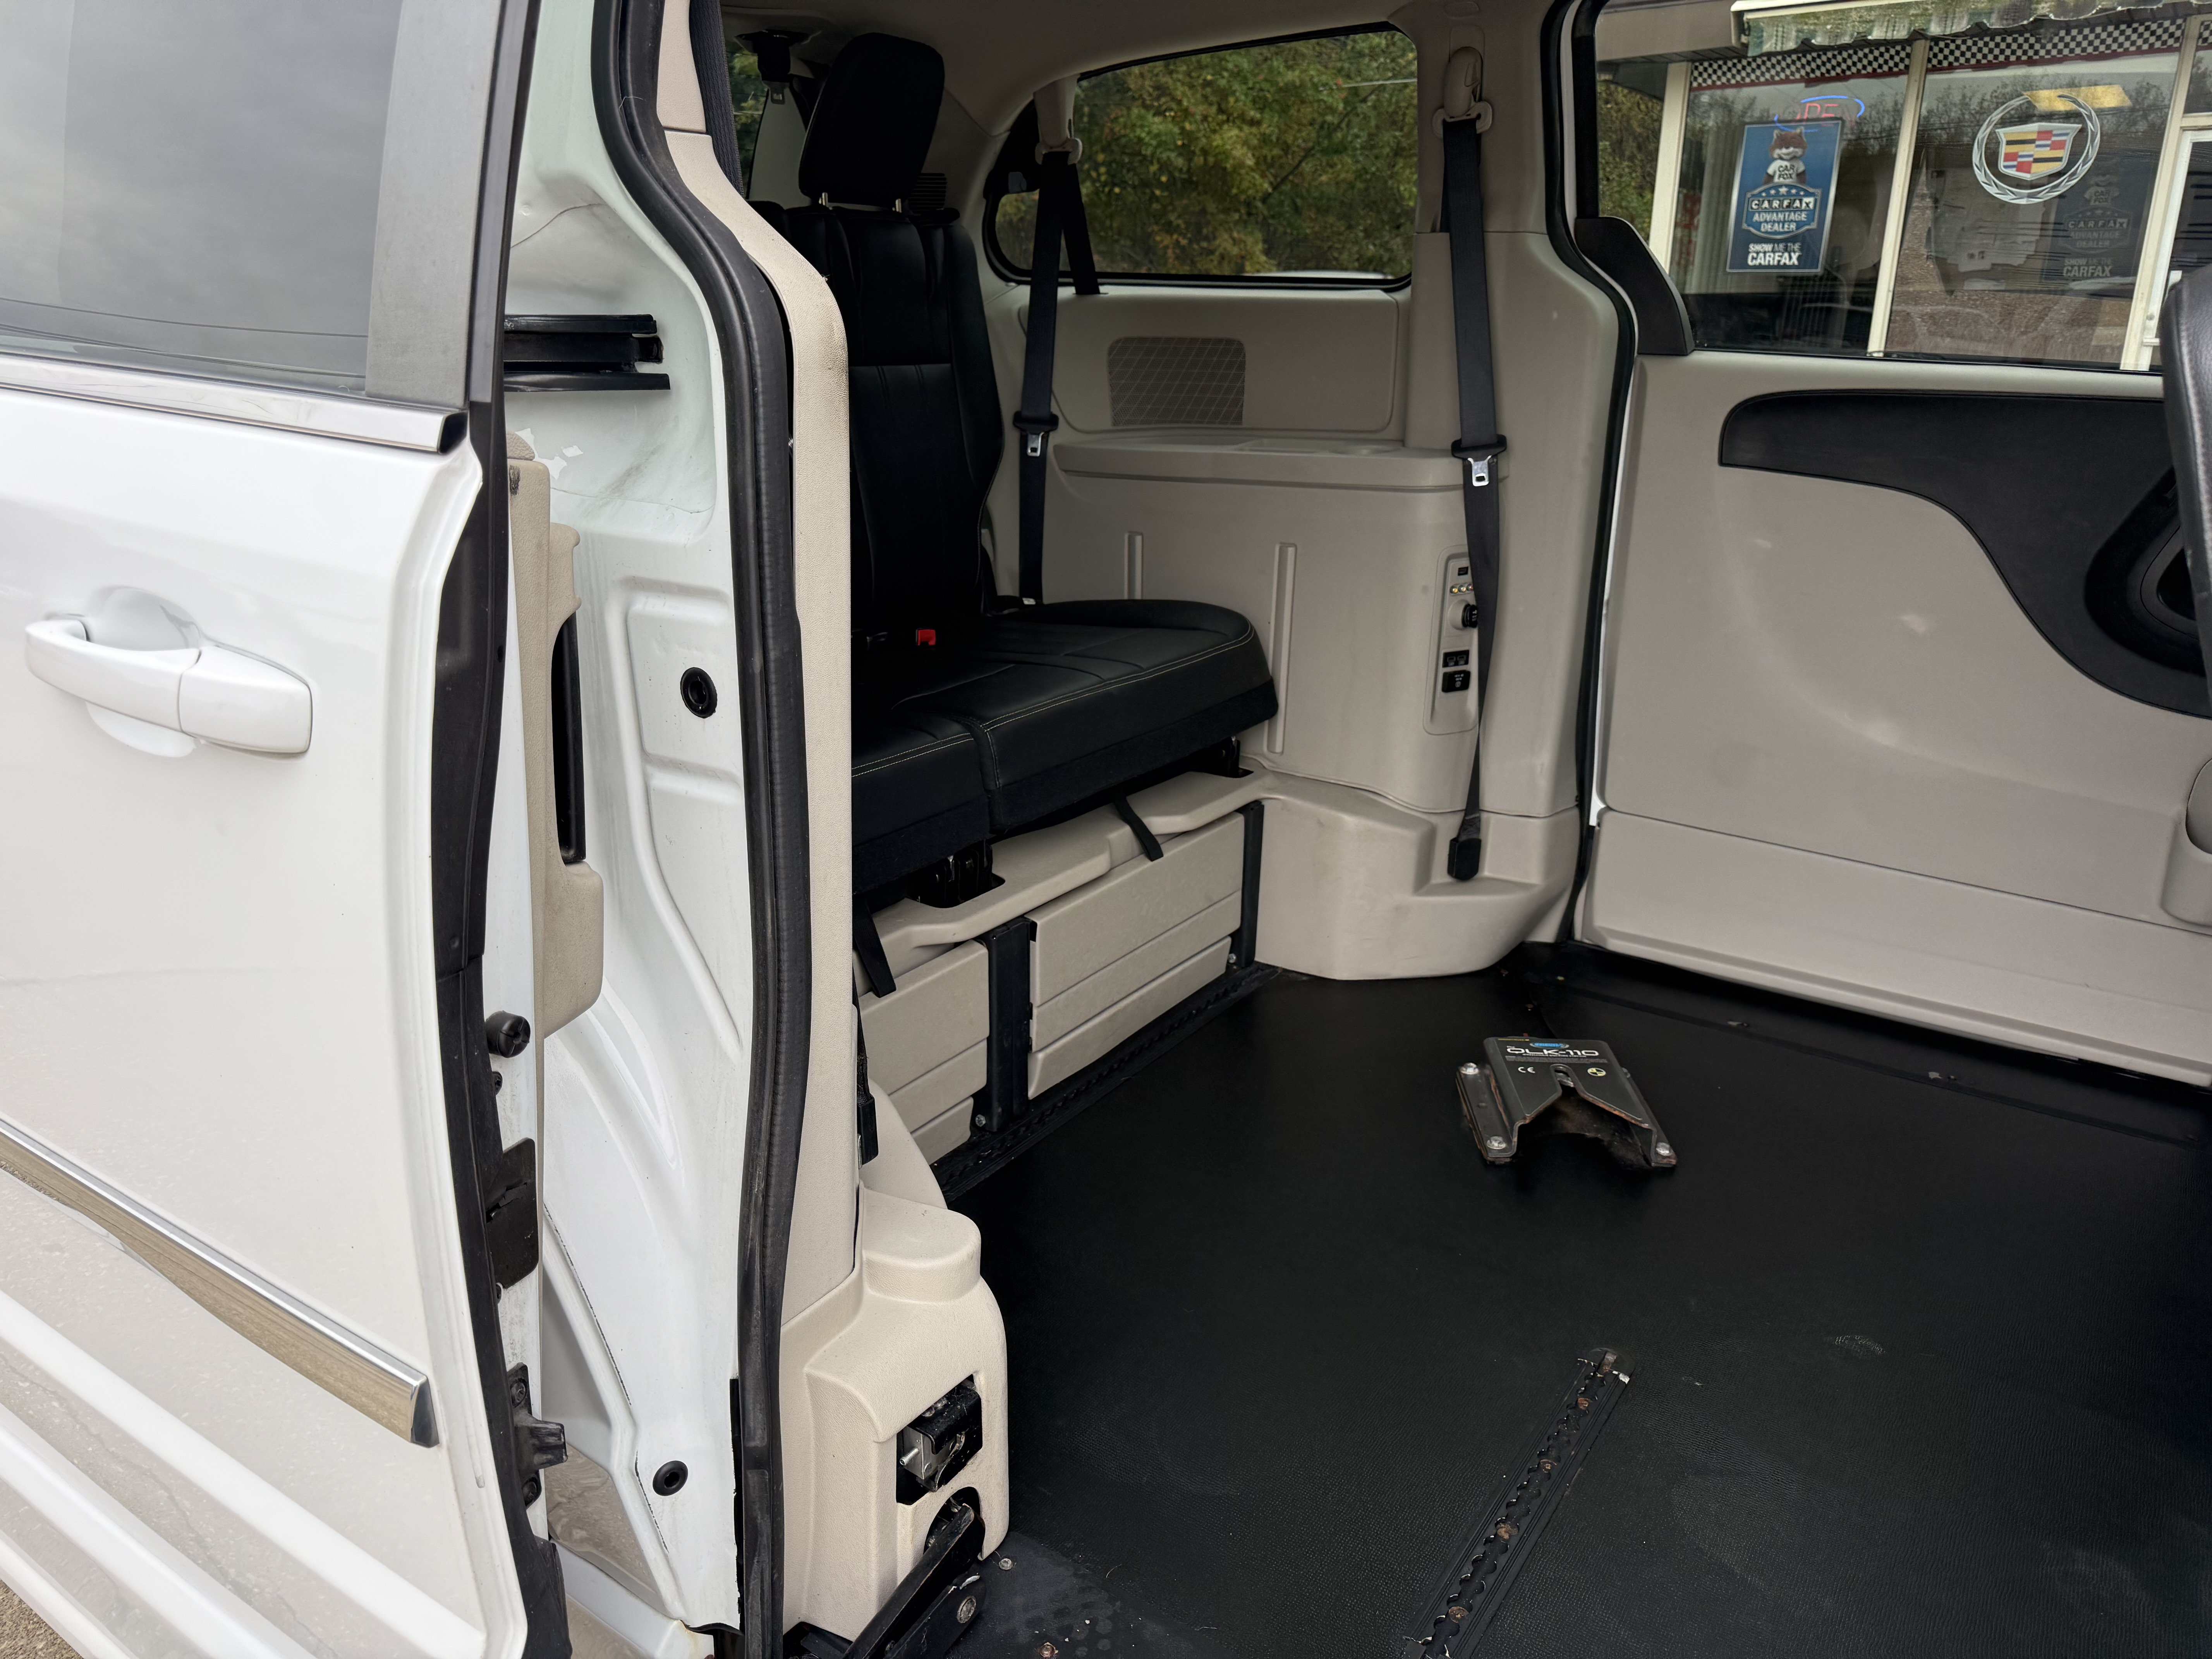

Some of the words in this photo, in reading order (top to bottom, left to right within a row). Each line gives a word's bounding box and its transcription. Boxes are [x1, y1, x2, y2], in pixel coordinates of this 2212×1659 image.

[1752, 199, 1812, 209] CARFAX
[1753, 212, 1807, 222] ADVANTAGE
[1761, 223, 1796, 232] DEALER
[2068, 219, 2126, 228] CARFAX
[1748, 243, 1773, 252] SHOW
[1773, 243, 1786, 251] ME
[1787, 242, 1801, 251] THE
[1747, 252, 1800, 266] CARFAX
[2063, 265, 2112, 277] CARFAX
[1507, 1048, 1599, 1056] QLK-110
